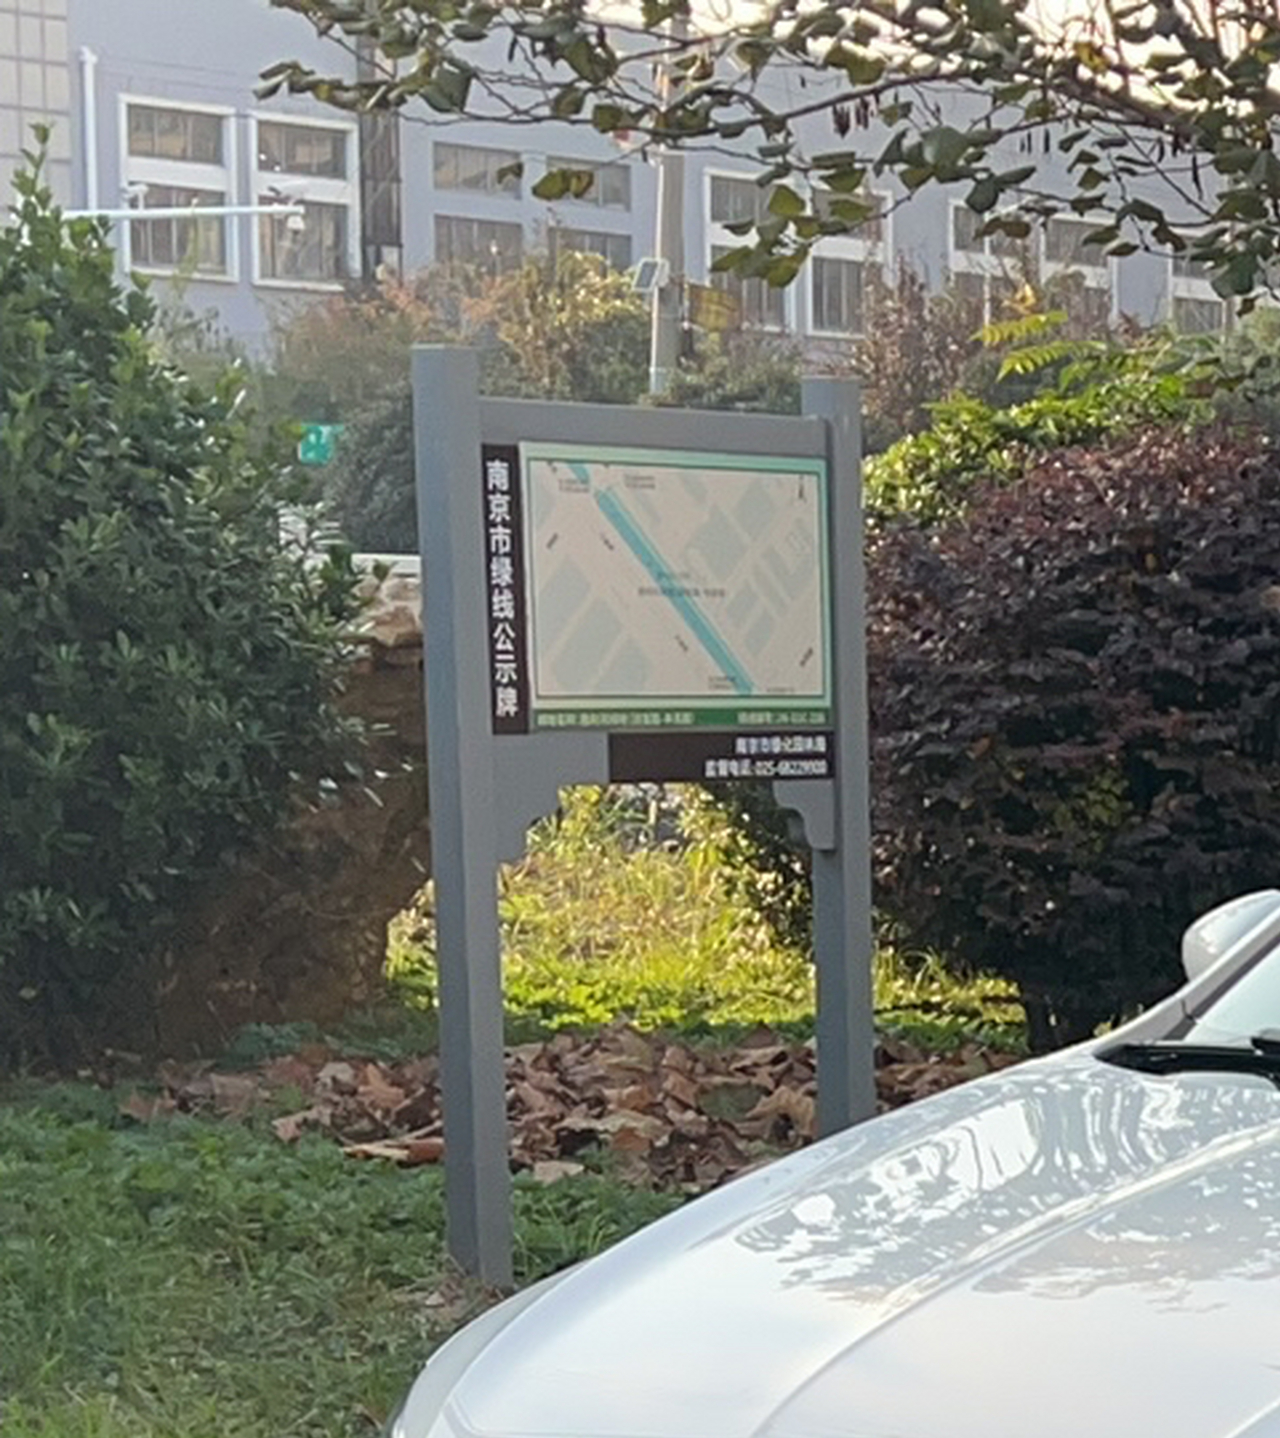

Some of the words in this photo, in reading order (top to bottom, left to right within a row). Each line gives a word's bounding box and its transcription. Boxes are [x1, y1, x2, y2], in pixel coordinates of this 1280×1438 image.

[487, 459, 519, 718] 南京市绿线公示牌
